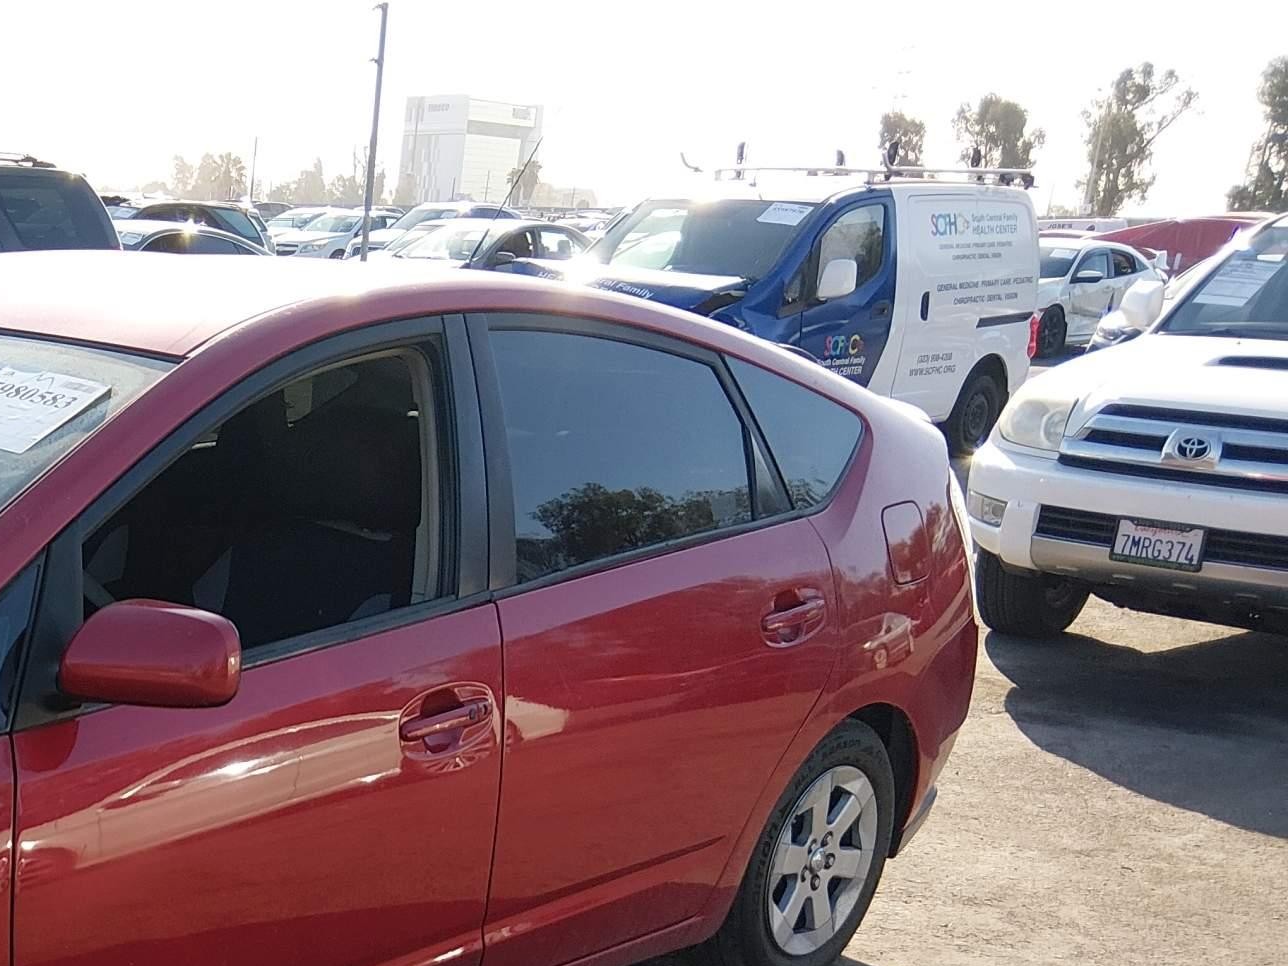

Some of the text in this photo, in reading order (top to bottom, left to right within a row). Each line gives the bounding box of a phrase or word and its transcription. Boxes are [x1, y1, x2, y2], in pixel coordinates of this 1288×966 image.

[996, 224, 1018, 234] CENTER
[615, 282, 654, 299] Family
[937, 282, 957, 292] GENERAL
[1120, 533, 1194, 566] 7MRG374
